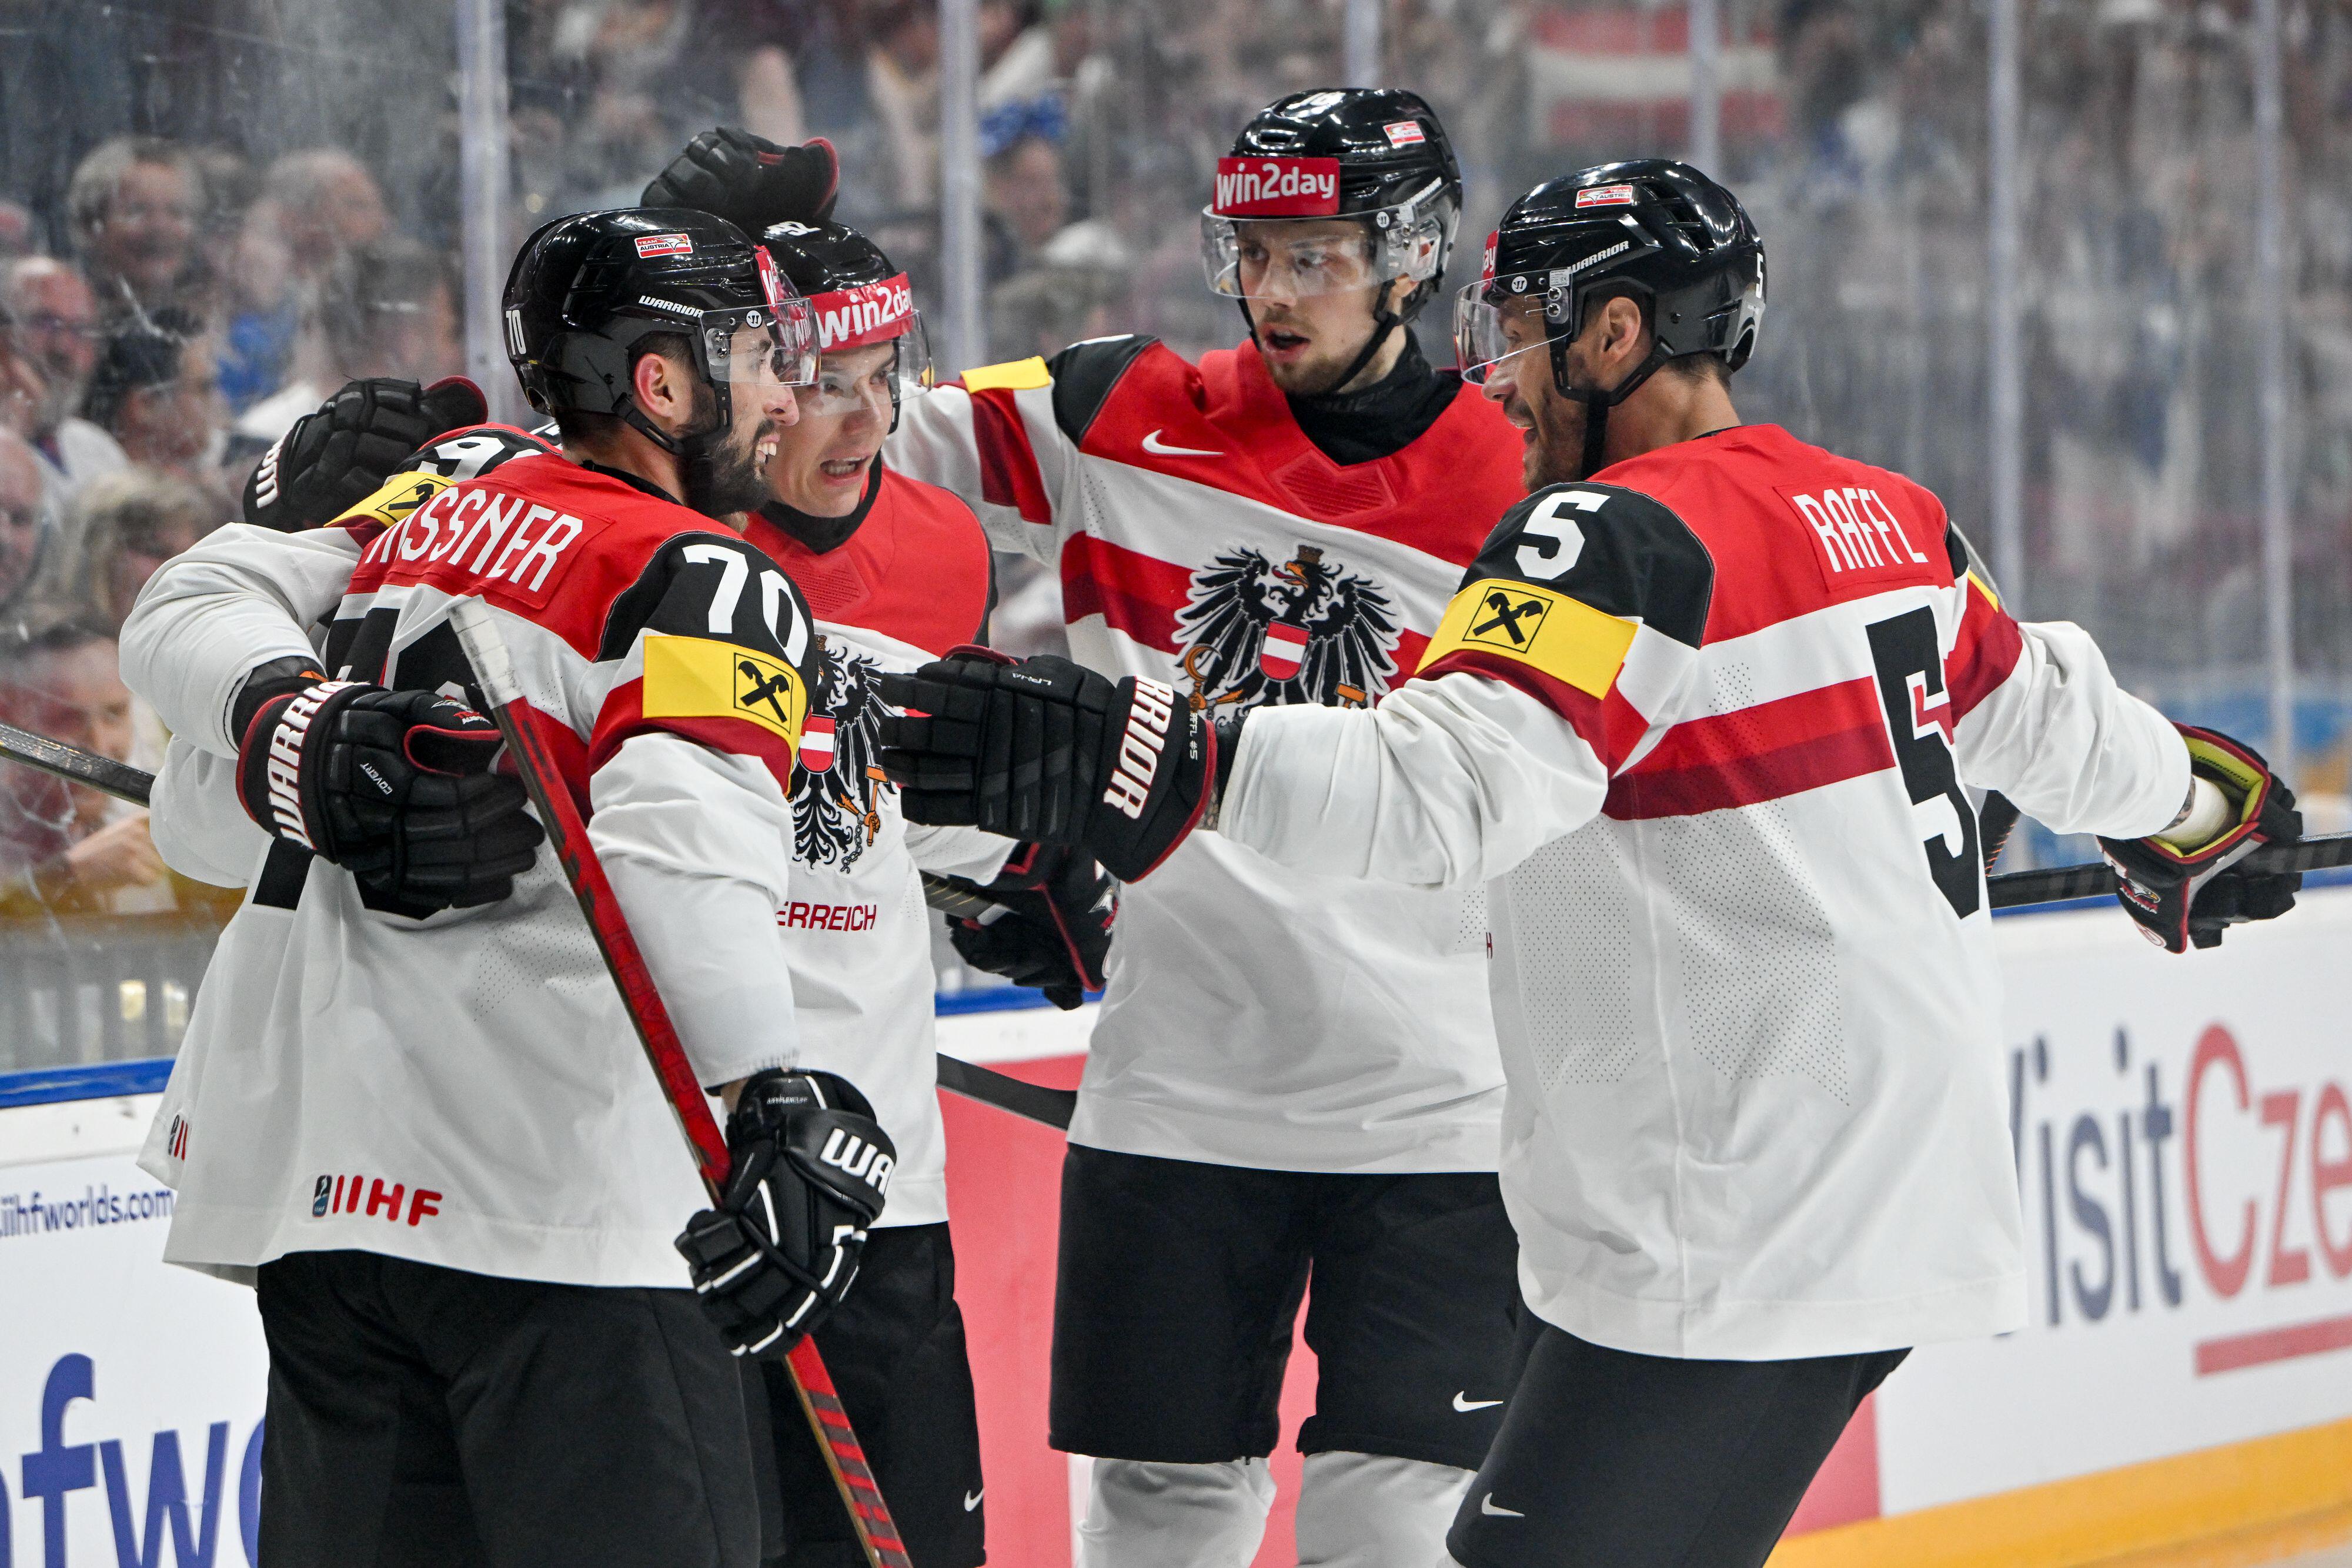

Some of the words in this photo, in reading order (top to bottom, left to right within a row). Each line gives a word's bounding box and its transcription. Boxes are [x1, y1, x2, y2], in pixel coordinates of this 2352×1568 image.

[1217, 162, 1335, 210] win2day
[640, 243, 670, 251] AUSTRIA
[1566, 240, 1629, 273] WARRIOR
[1755, 252, 1763, 299] 5
[639, 295, 704, 318] WARRIOR
[506, 309, 527, 355] 70
[1515, 489, 1612, 580] 5
[1791, 487, 1929, 573] RAFFL
[682, 543, 808, 668] 70
[268, 681, 370, 850] WARRIO
[359, 763, 393, 795] COVERT
[1865, 605, 1980, 920] 5
[332, 1175, 443, 1227] IIHF
